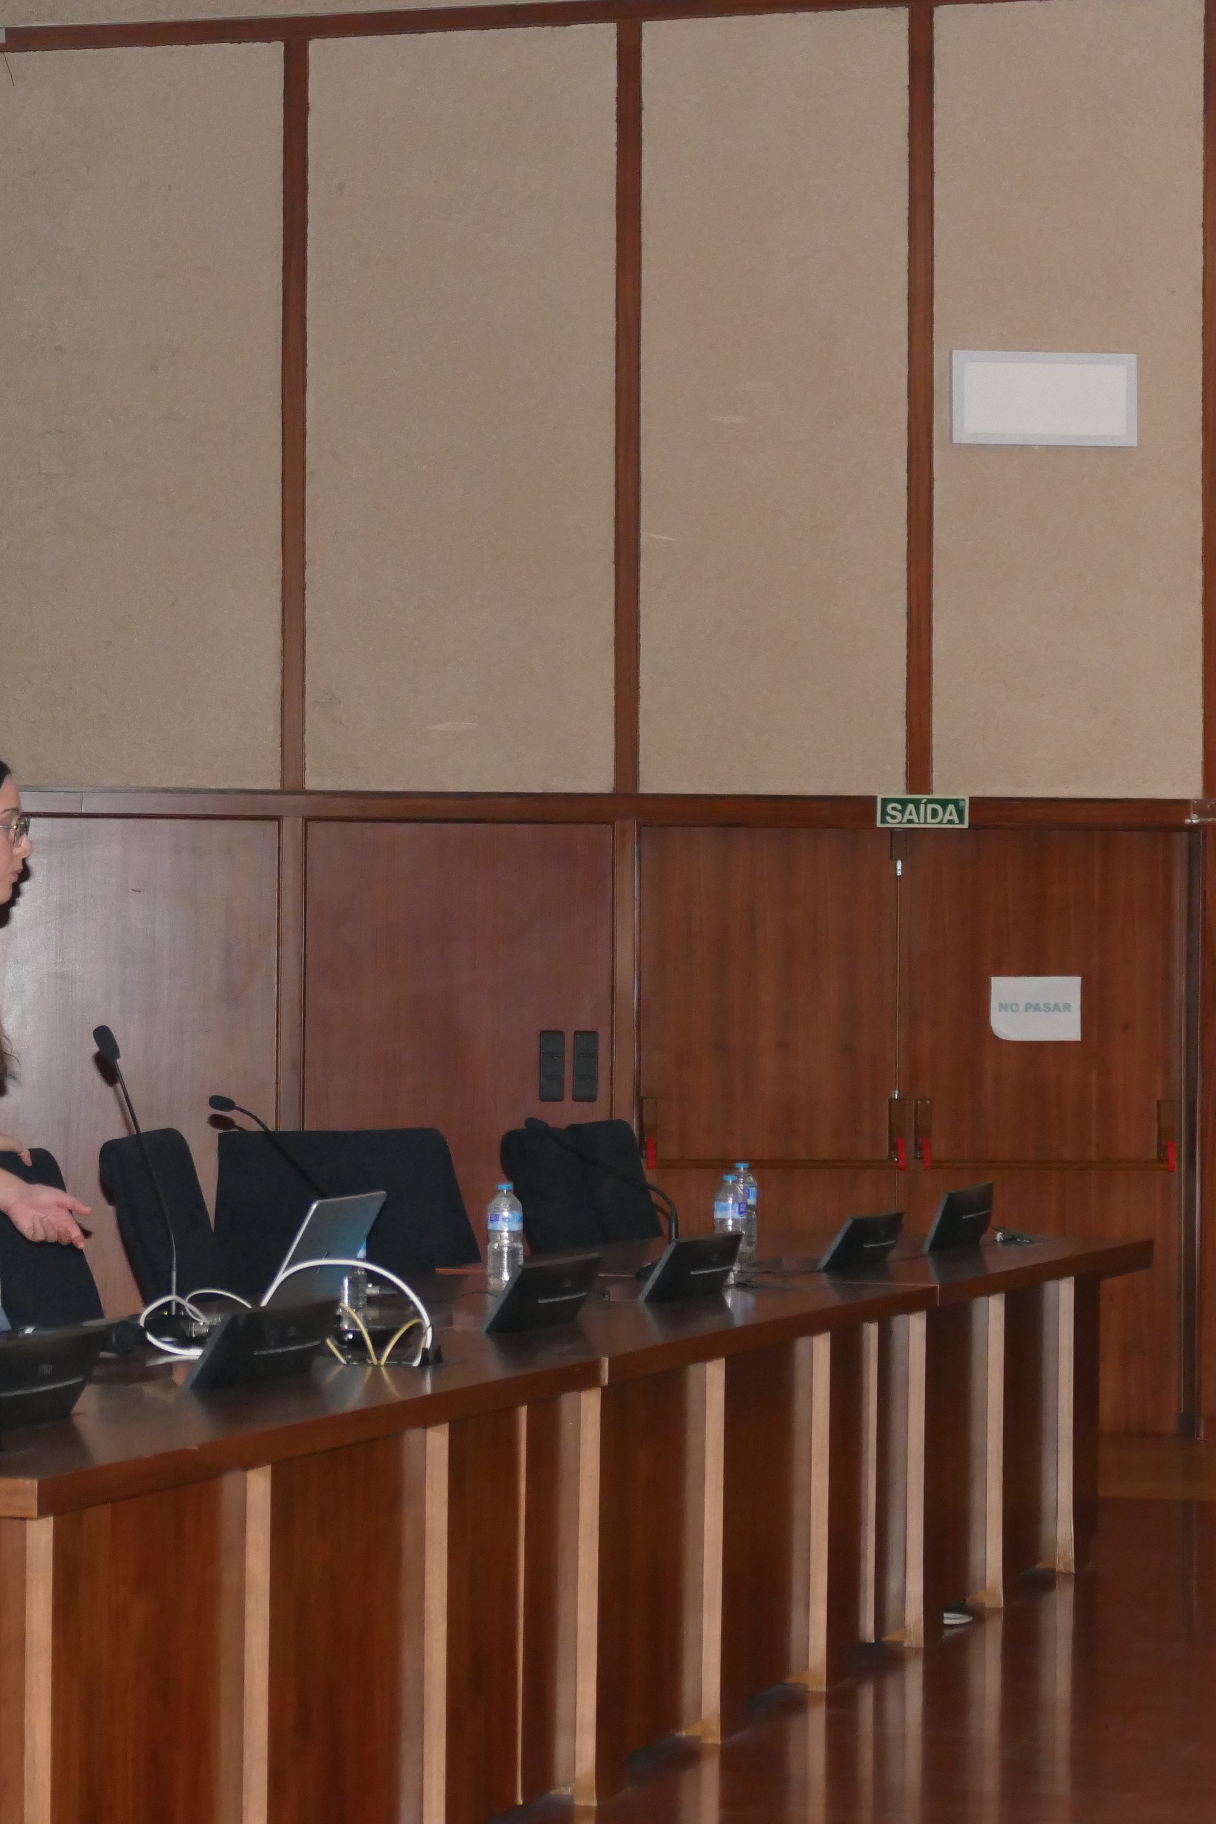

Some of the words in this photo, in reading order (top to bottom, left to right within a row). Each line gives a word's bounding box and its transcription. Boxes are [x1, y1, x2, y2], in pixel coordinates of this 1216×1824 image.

[885, 799, 960, 824] SAÍDA
[998, 1002, 1020, 1013] NO
[1025, 1002, 1072, 1013] PASAR
